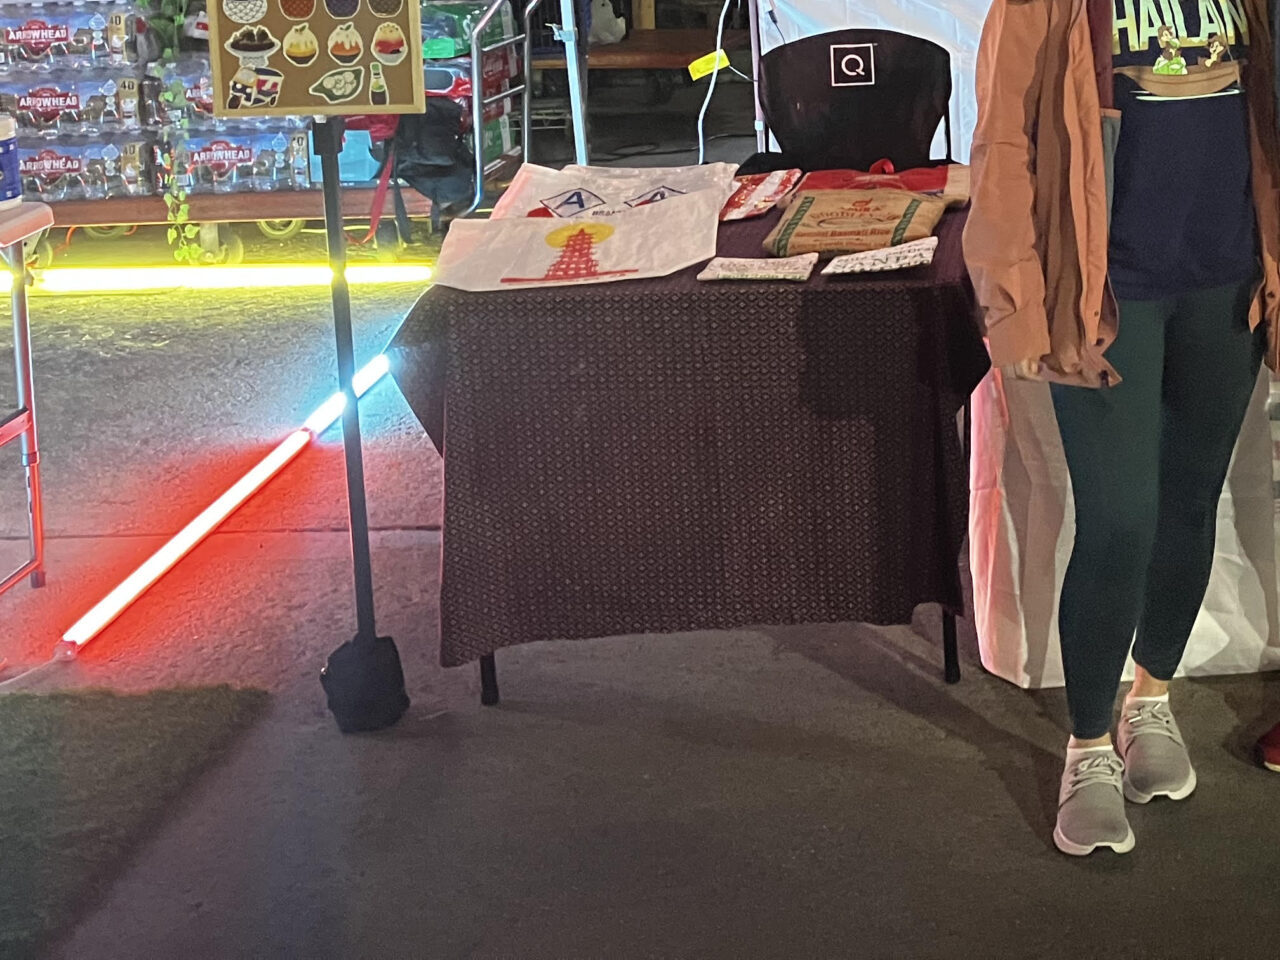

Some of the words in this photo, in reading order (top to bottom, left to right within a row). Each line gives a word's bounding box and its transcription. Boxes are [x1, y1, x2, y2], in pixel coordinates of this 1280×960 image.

[8, 29, 67, 40] ARROWHEAD
[841, 54, 866, 76] Q
[120, 80, 135, 90] 40
[19, 96, 78, 107] ARROWHEAD
[193, 150, 251, 161] ARROWHEAD
[20, 160, 79, 171] ARROWHEAD
